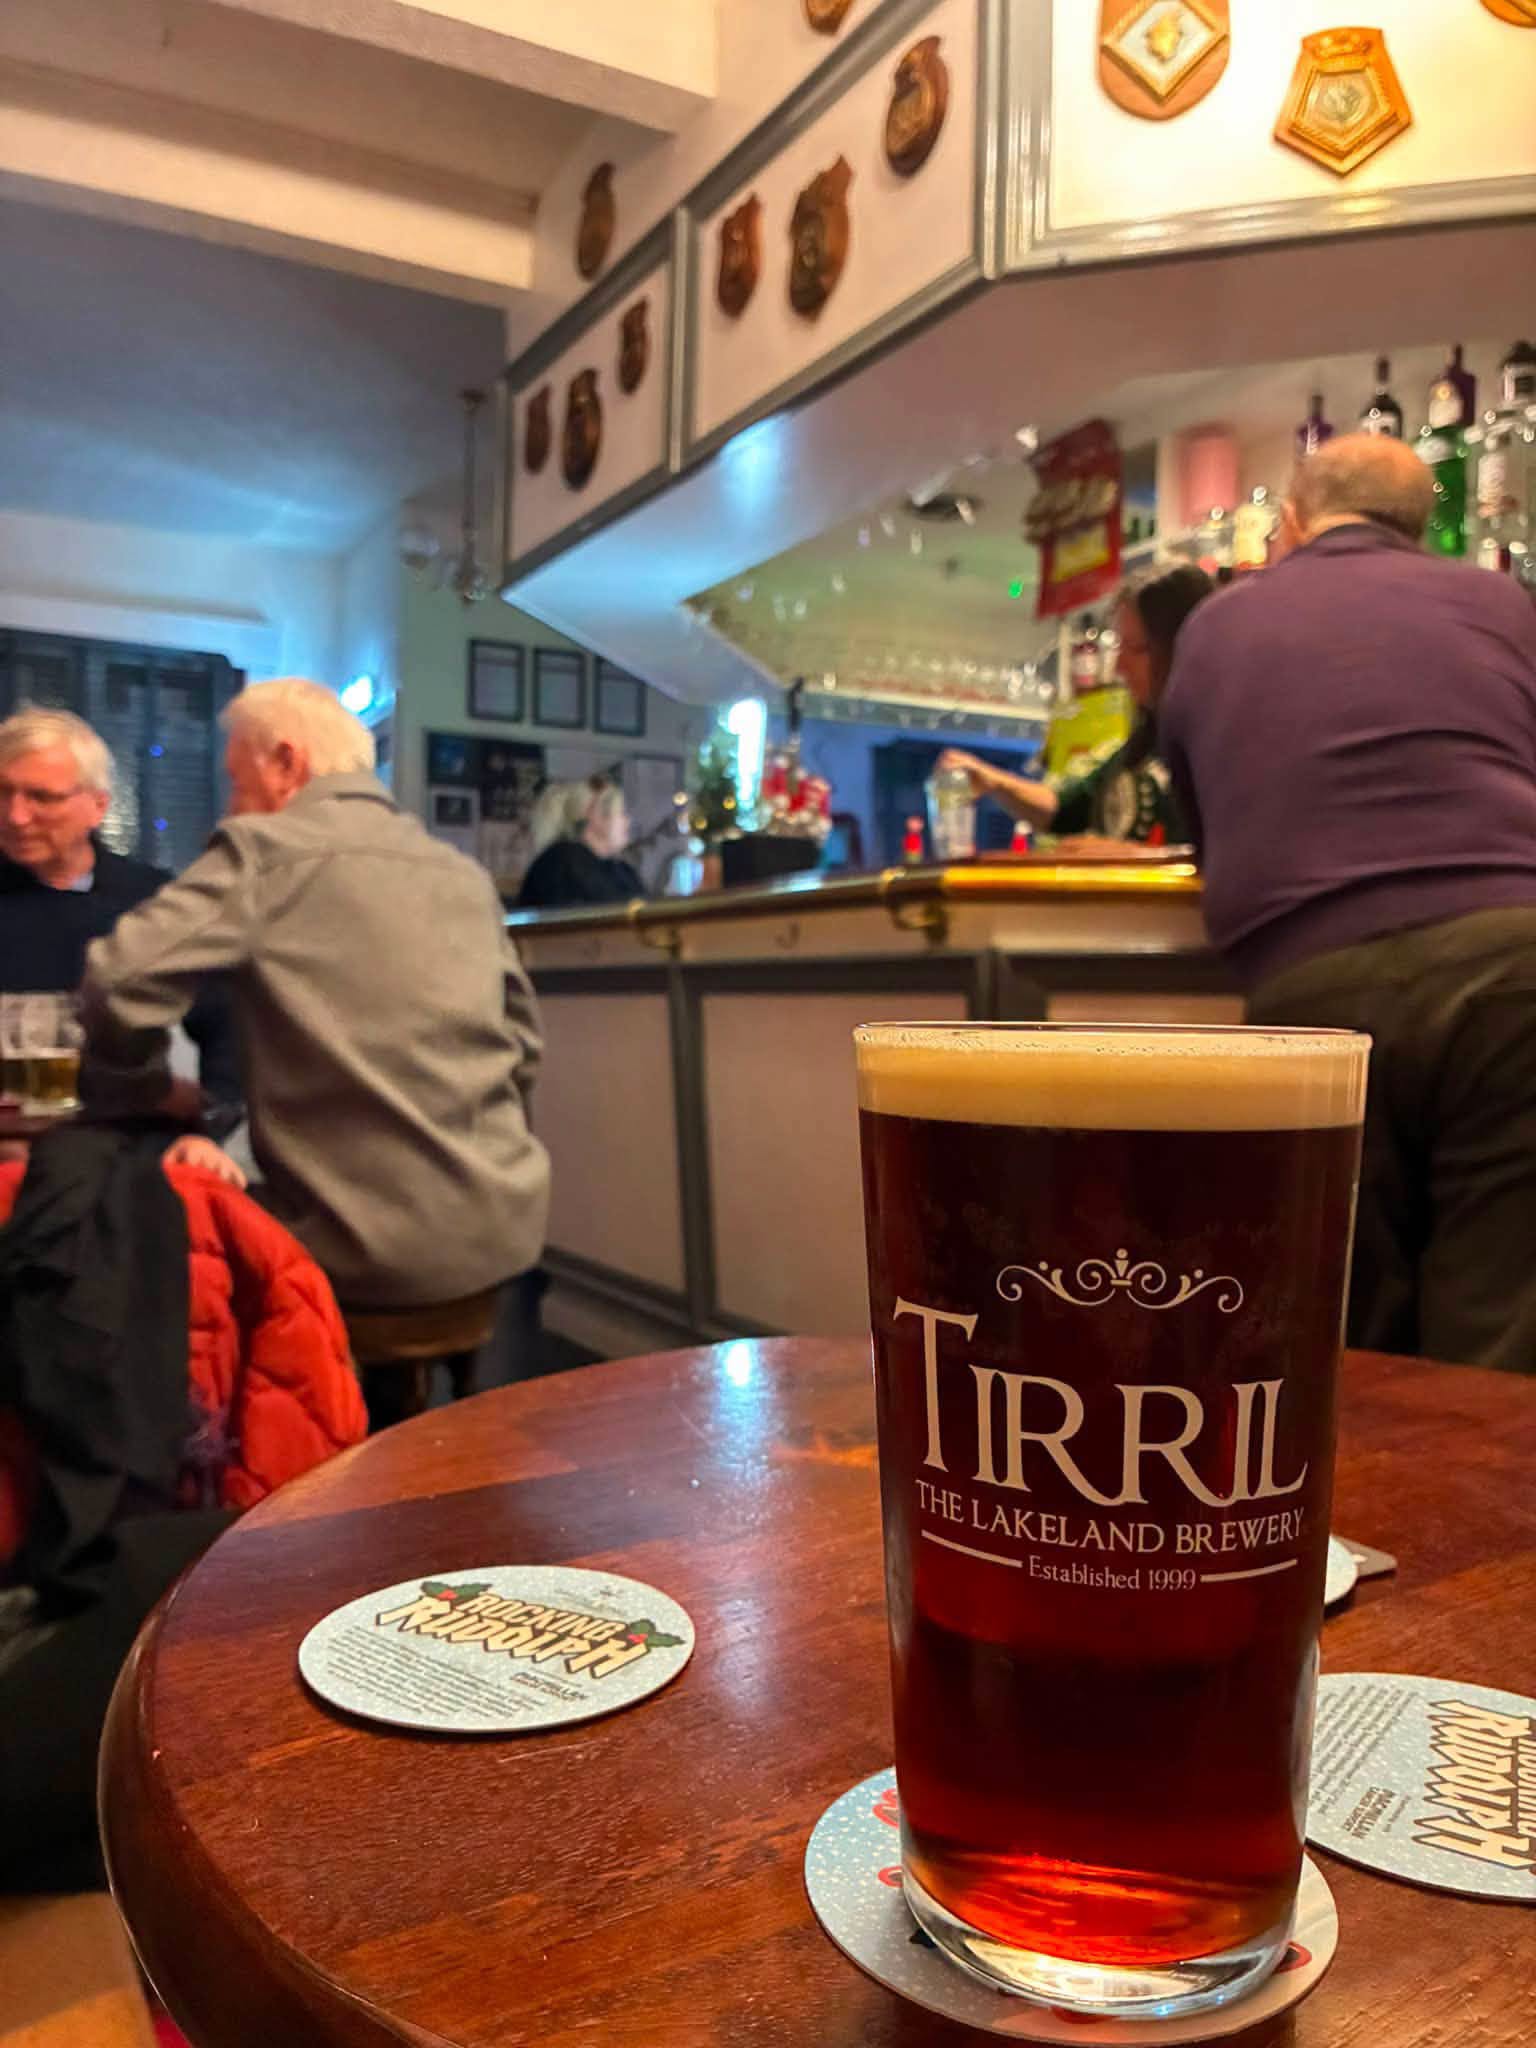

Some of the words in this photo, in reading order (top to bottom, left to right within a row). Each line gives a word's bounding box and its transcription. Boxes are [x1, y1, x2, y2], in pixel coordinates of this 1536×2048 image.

[893, 1296, 1308, 1507] TIRRIL
[915, 1479, 964, 1524] THE
[971, 1499, 1165, 1554] LAKELAND
[1175, 1506, 1305, 1554] BREWERY
[1029, 1555, 1141, 1590] Established
[1148, 1568, 1197, 1591] 1999
[375, 1595, 652, 1680] RUDOLPH
[452, 1592, 626, 1642] ROCKING
[1411, 1699, 1536, 1869] RUDOLPH
